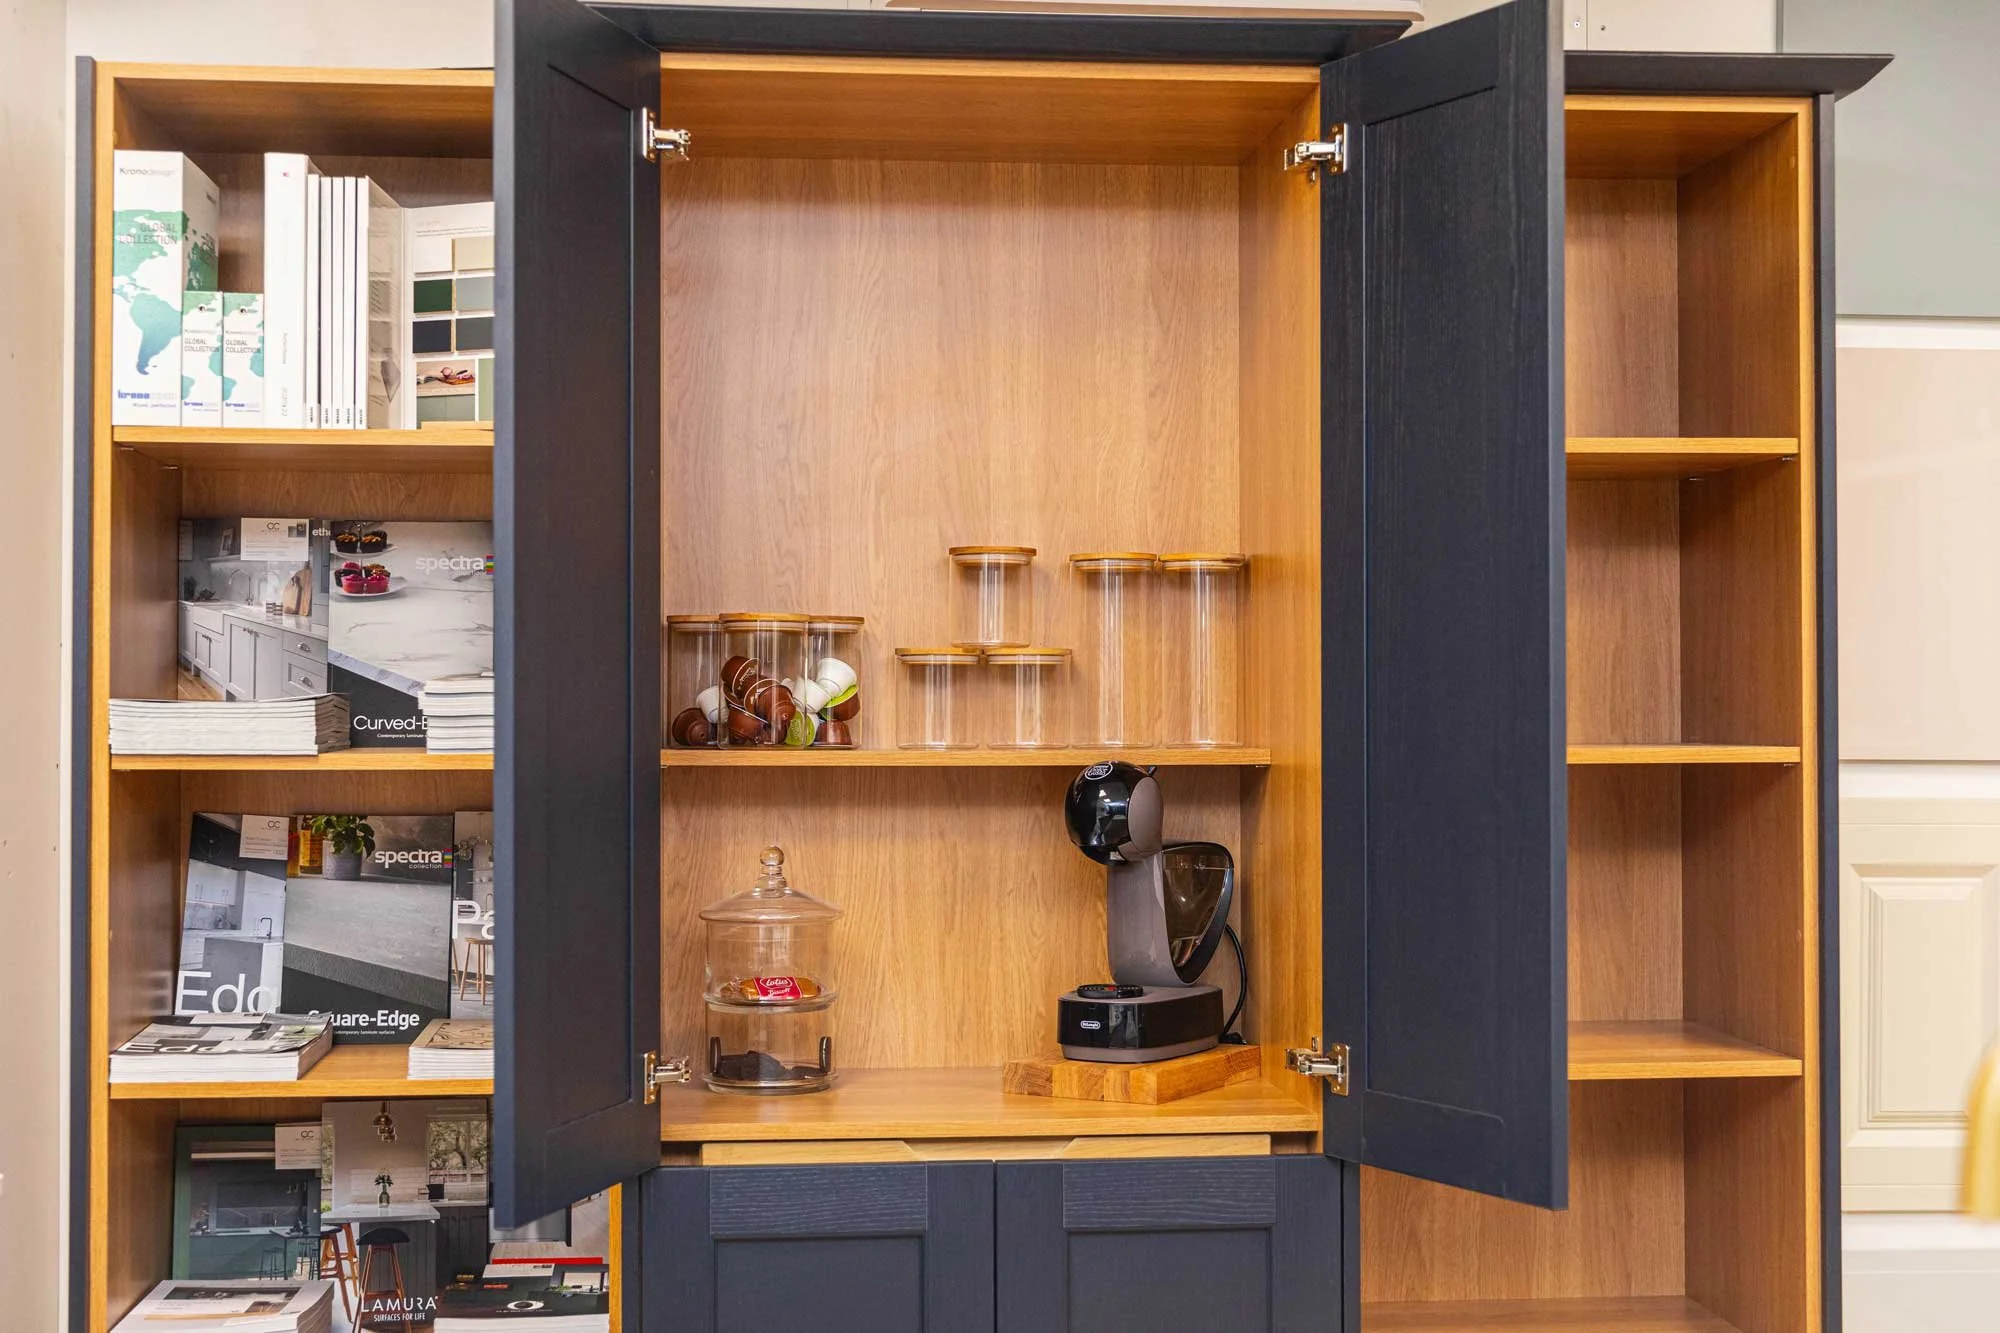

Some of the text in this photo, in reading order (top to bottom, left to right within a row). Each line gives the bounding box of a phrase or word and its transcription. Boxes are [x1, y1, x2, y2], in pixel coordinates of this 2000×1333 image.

[415, 556, 484, 575] spectra
[374, 849, 442, 869] spectra
[308, 1010, 420, 1030] uare-Edge
[361, 1296, 437, 1313] LAMURA
[373, 1312, 426, 1322] SURFACES FOR LIFE
